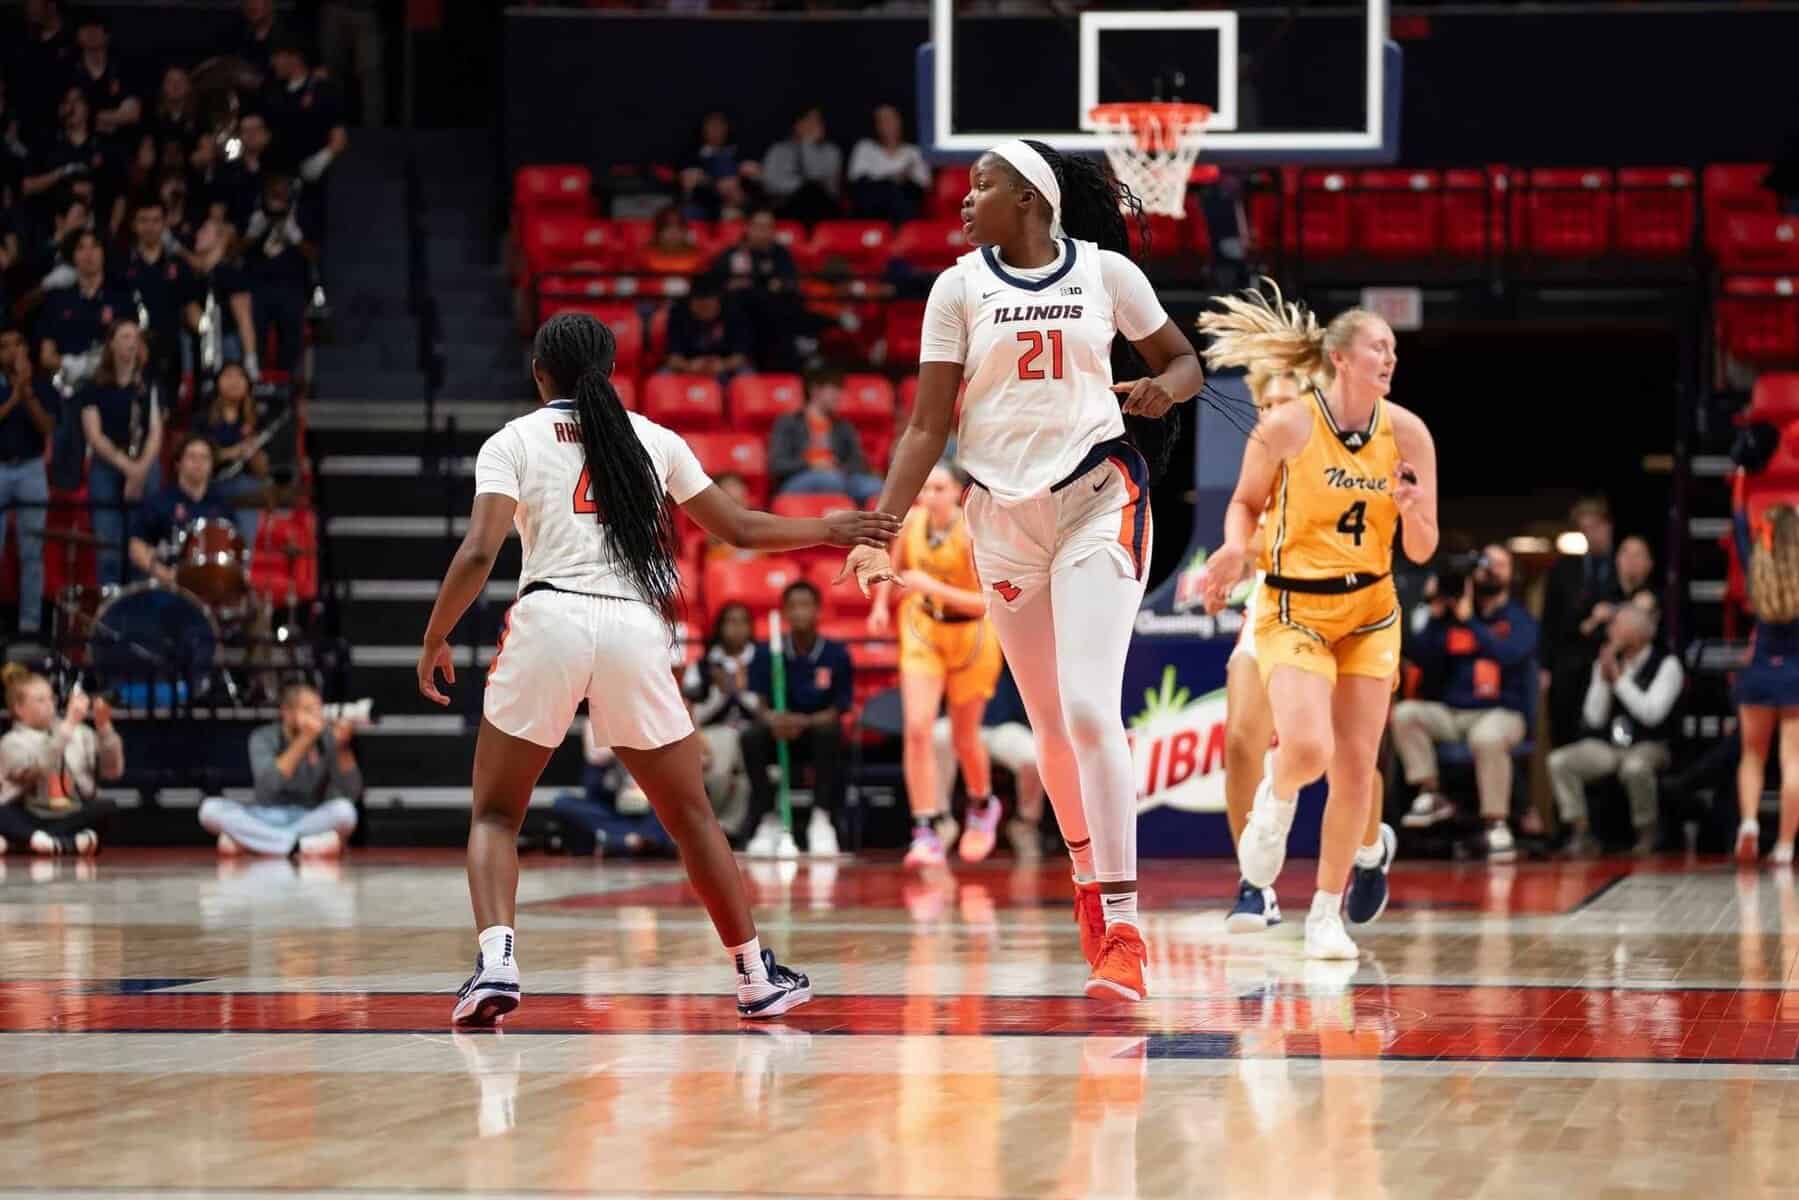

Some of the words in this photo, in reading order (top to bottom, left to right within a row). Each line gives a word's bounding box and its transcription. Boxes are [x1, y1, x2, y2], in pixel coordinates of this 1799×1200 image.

[994, 305, 1083, 324] ILLINOIS
[1016, 330, 1063, 379] 21
[554, 422, 584, 443] RH
[1324, 466, 1388, 490] Norse
[1336, 500, 1366, 546] 4
